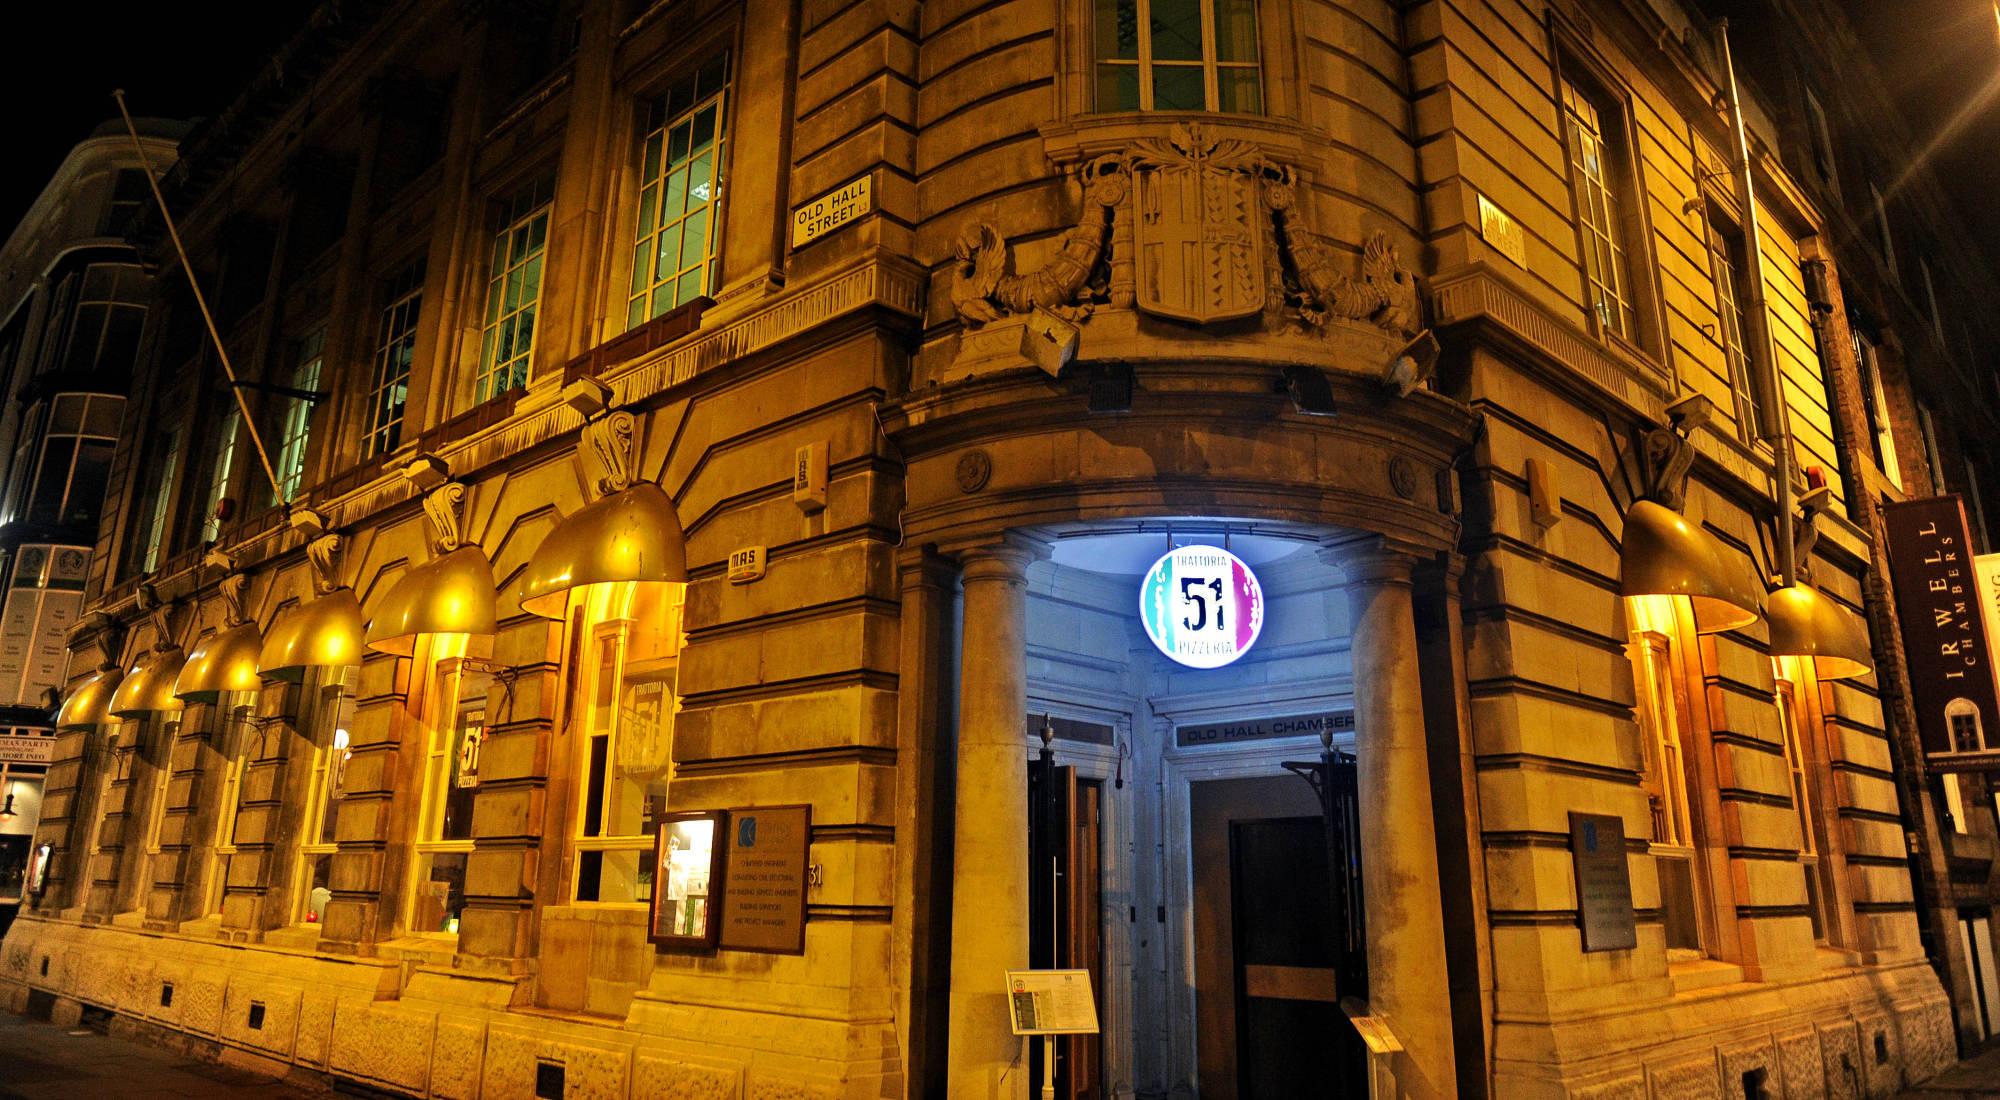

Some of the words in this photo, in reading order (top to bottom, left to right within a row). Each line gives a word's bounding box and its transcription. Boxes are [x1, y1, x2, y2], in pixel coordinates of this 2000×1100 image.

[798, 203, 823, 225] OLD
[832, 183, 865, 208] HALL
[807, 203, 855, 236] STREET
[732, 550, 755, 568] MAS
[1177, 555, 1227, 566] TRATTORIA
[1181, 577, 1225, 631] 51
[1920, 522, 1964, 678] IRWELL
[1942, 537, 1976, 666] CHAMBERS
[1179, 641, 1233, 655] PIZZERIA
[461, 726, 482, 771] 51
[1187, 729, 1217, 741] OLD
[1224, 725, 1265, 737] HALL
[808, 864, 823, 887] 31
